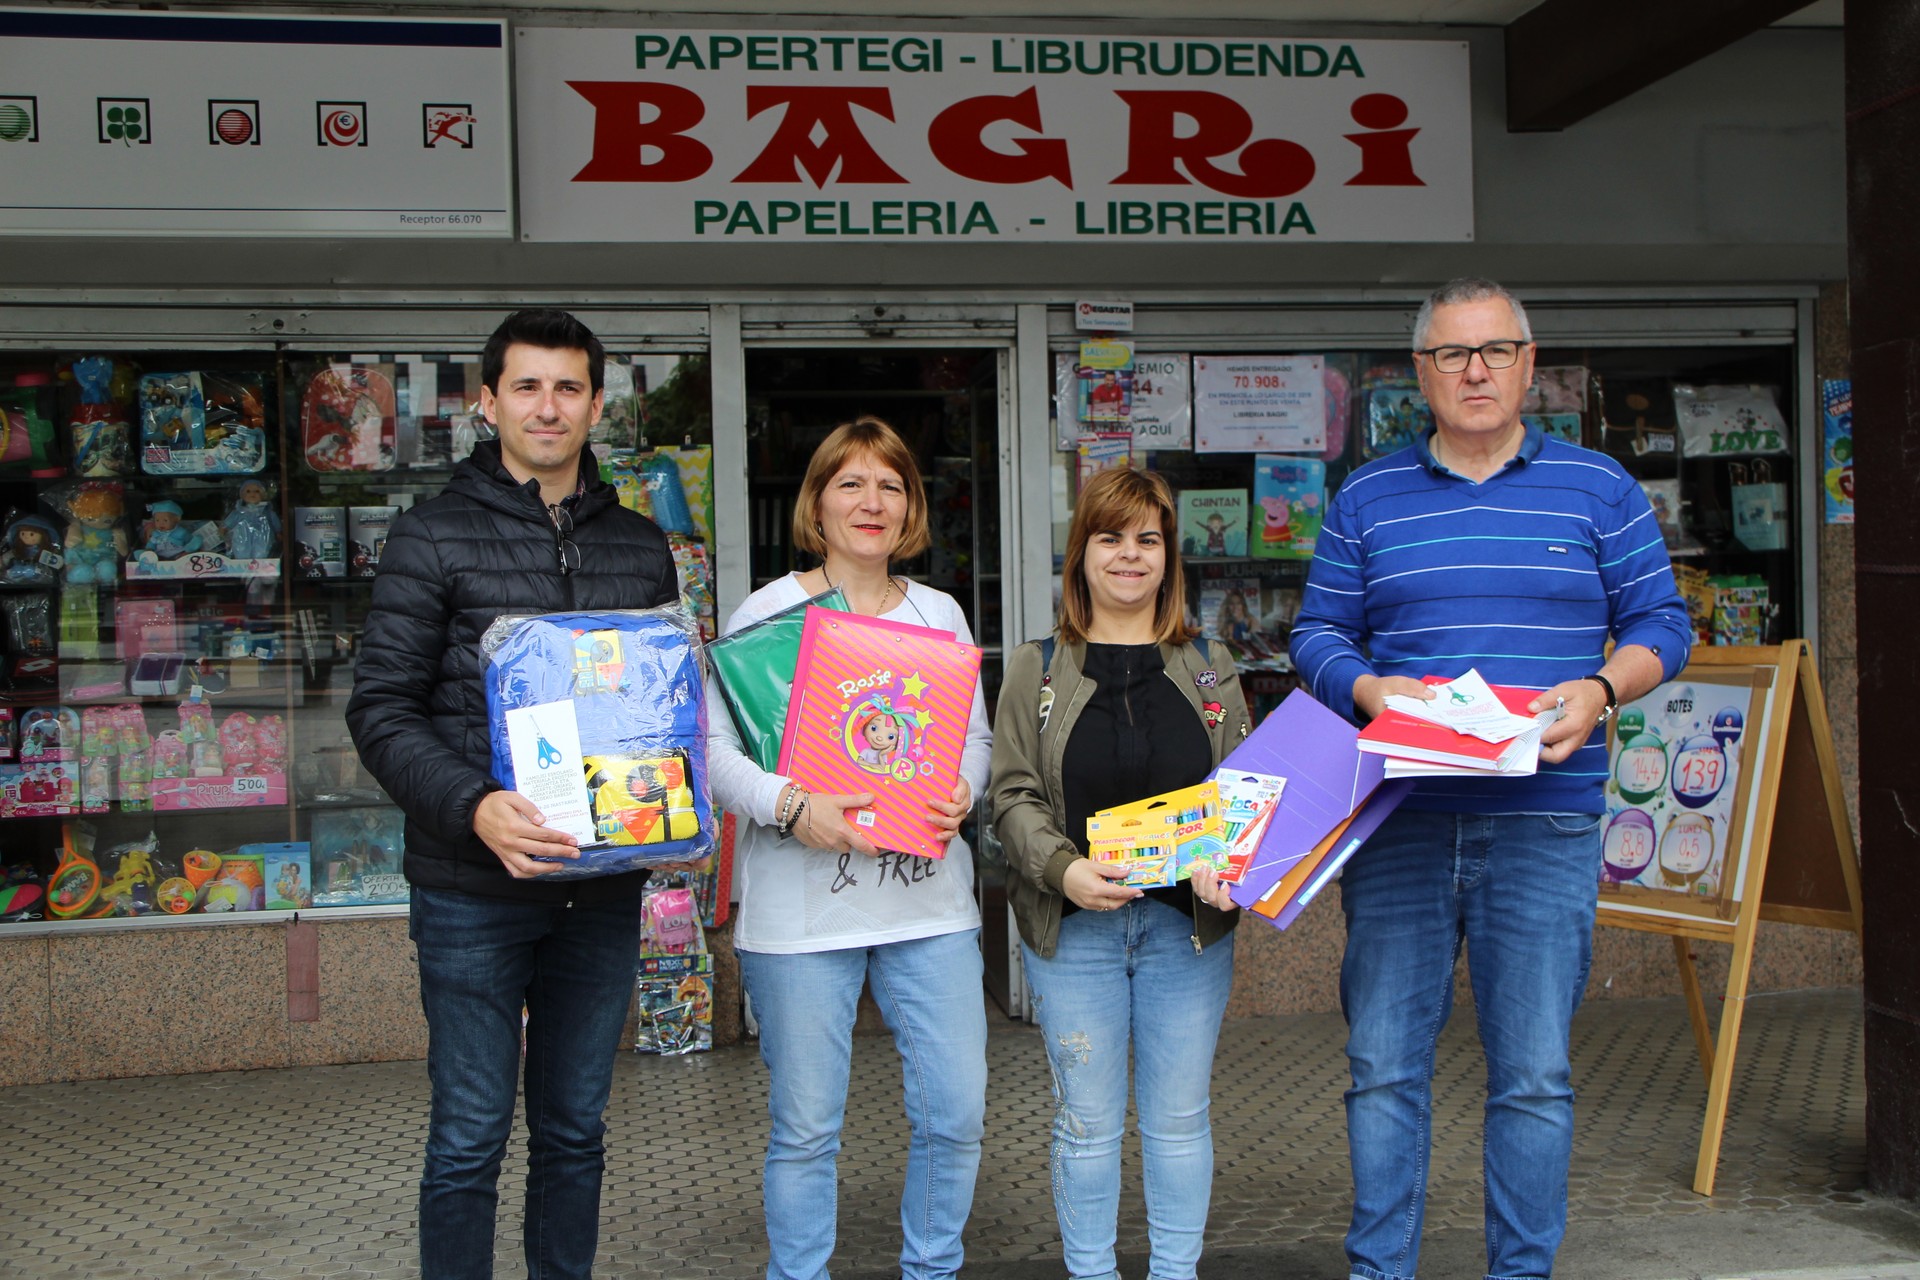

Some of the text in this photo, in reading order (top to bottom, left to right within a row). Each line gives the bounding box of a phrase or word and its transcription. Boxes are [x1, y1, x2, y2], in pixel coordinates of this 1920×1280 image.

[635, 35, 943, 73] PAPERTEGI
[992, 39, 1366, 78] LIBURUDENDA
[400, 214, 482, 225] Receptor 66.070
[694, 200, 999, 235] PAPELERIA
[1076, 201, 1317, 235] LIBRERIA
[1139, 422, 1172, 435] AQUÍ
[1709, 430, 1781, 453] LOVE
[1191, 497, 1241, 508] CHINTAN
[836, 669, 892, 699] Rosie
[1667, 699, 1693, 713] BOTES
[894, 759, 912, 779] R
[1679, 758, 1719, 792] 139
[363, 873, 400, 884] OFERTA
[830, 850, 937, 894] & FREE
